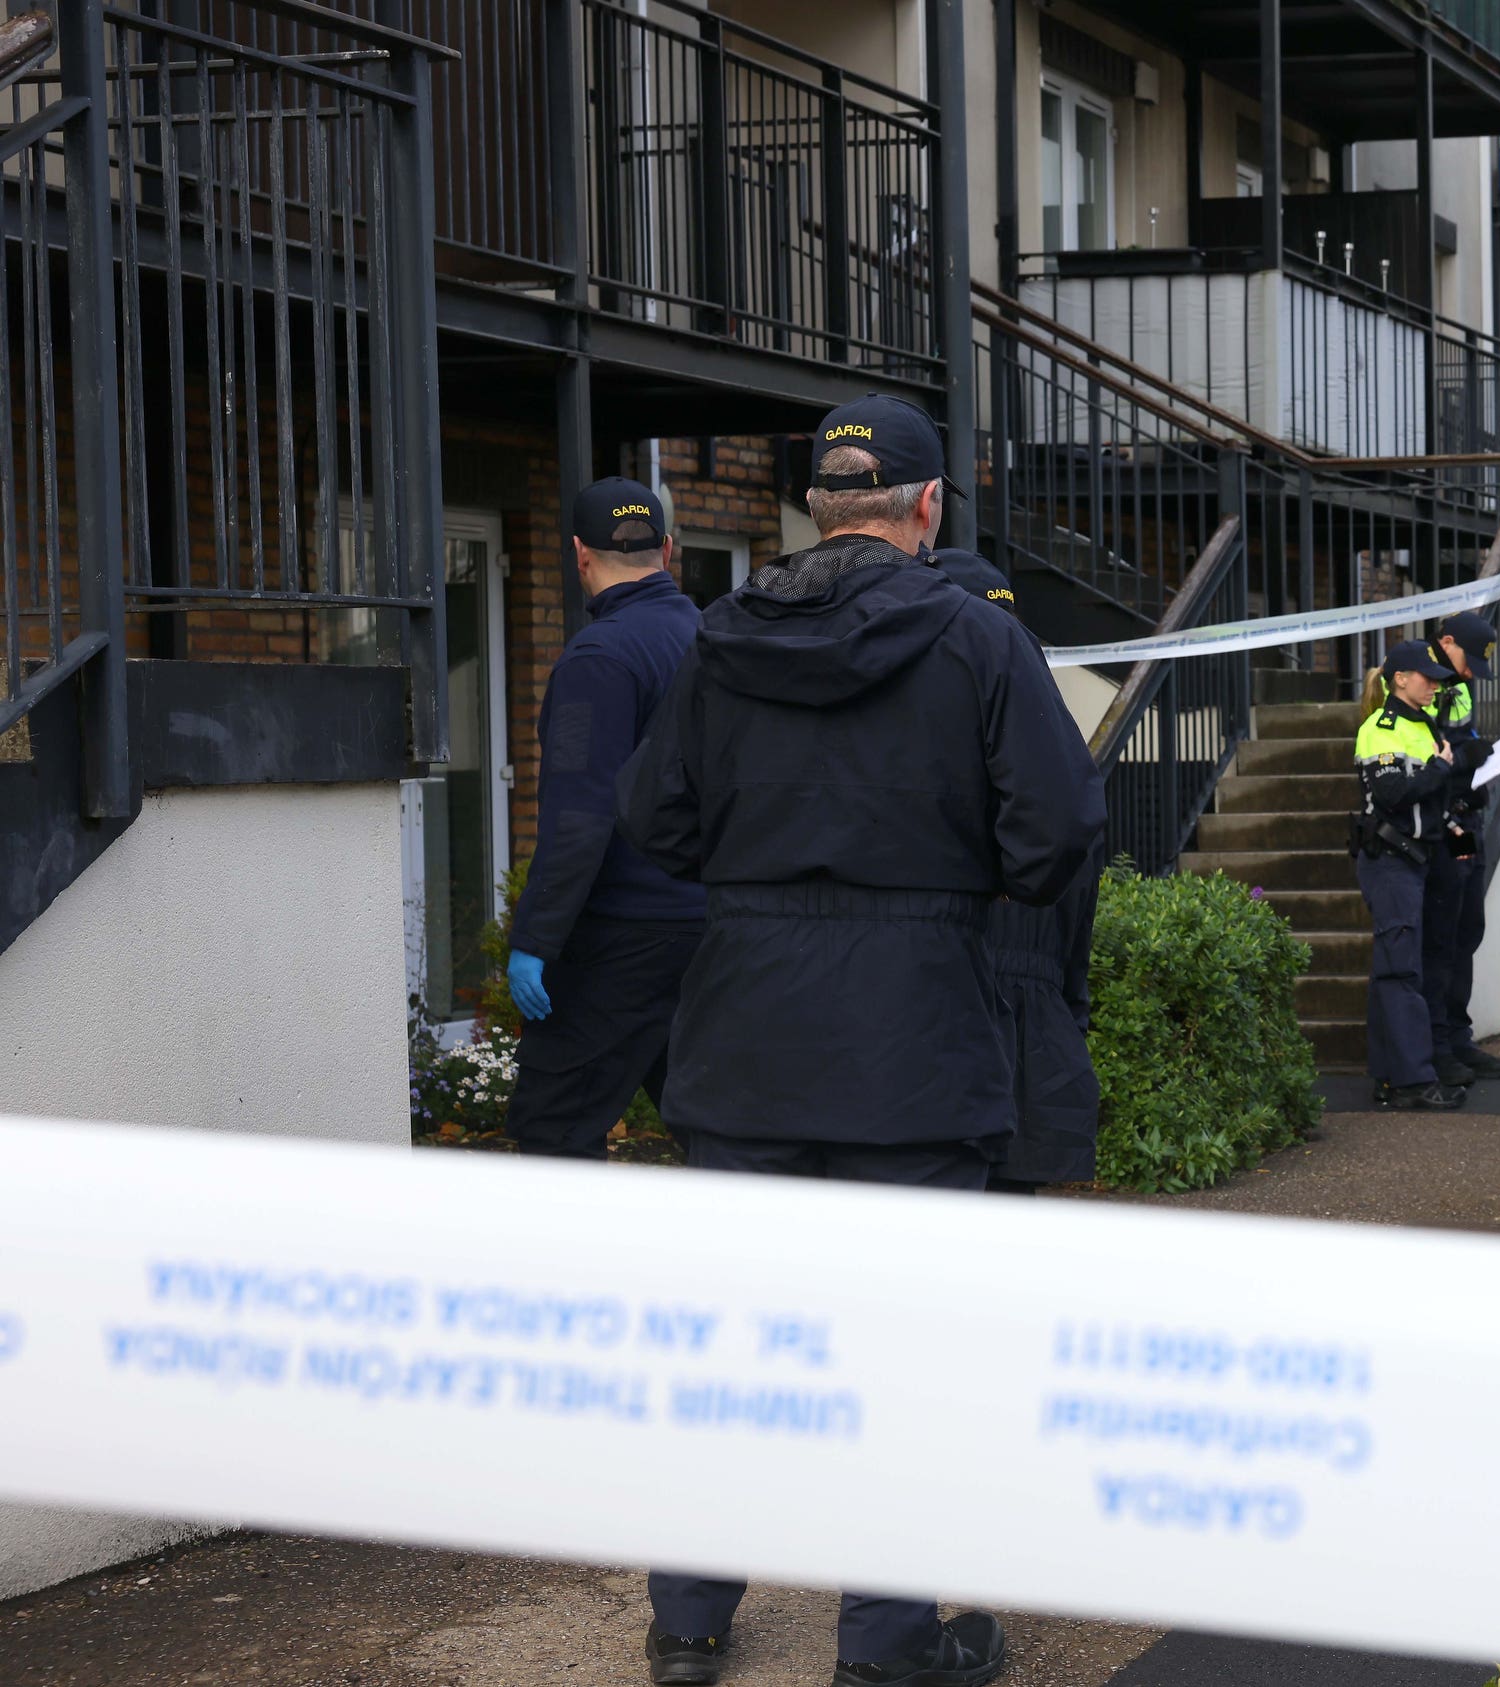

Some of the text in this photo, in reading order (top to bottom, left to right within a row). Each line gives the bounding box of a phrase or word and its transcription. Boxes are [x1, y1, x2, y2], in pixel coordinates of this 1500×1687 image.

[825, 424, 872, 441] GARDA
[612, 504, 651, 517] GARDA
[435, 1285, 629, 1347] GARDA
[640, 1303, 720, 1355] AN
[1053, 1322, 1374, 1396] 1800-666111
[668, 1381, 863, 1440] UIMHIR
[1040, 1391, 1373, 1474] Confidential
[1093, 1472, 1305, 1541] GARDA
